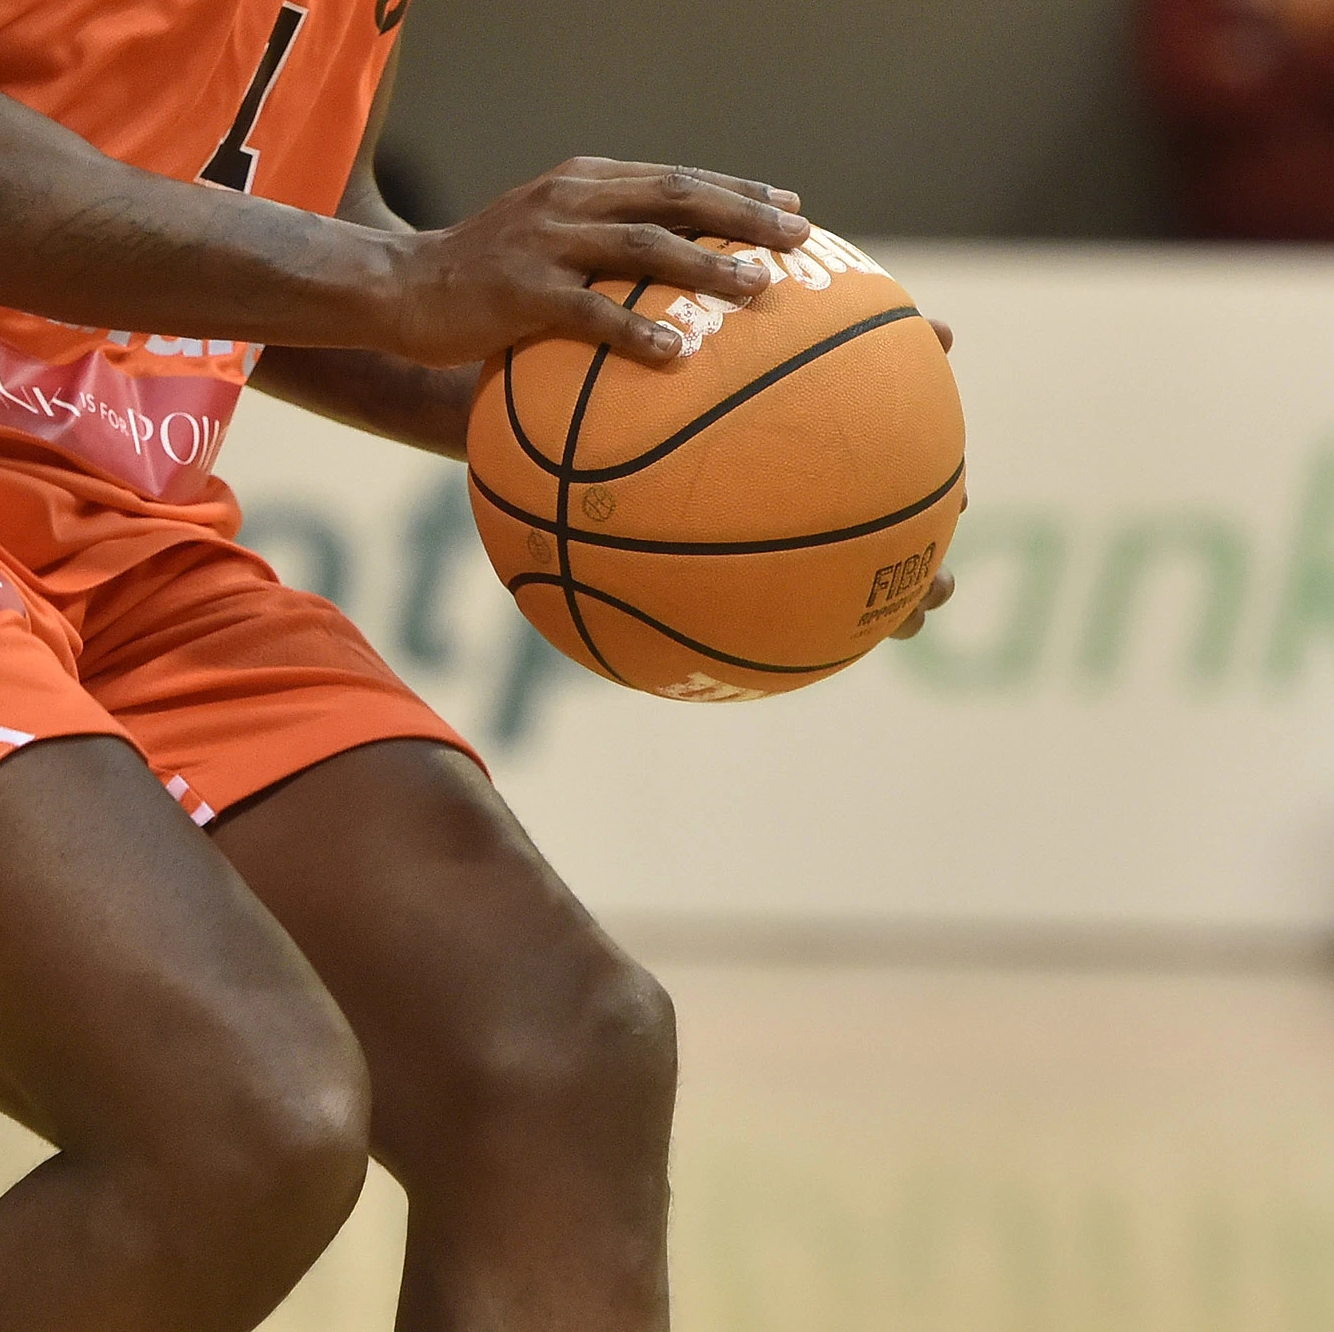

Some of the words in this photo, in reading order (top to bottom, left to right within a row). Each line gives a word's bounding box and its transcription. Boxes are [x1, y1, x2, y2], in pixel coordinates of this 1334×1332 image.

[193, 0, 309, 195] 1
[79, 391, 97, 413] IS
[99, 402, 130, 437] FOR
[865, 541, 936, 608] FIBA
